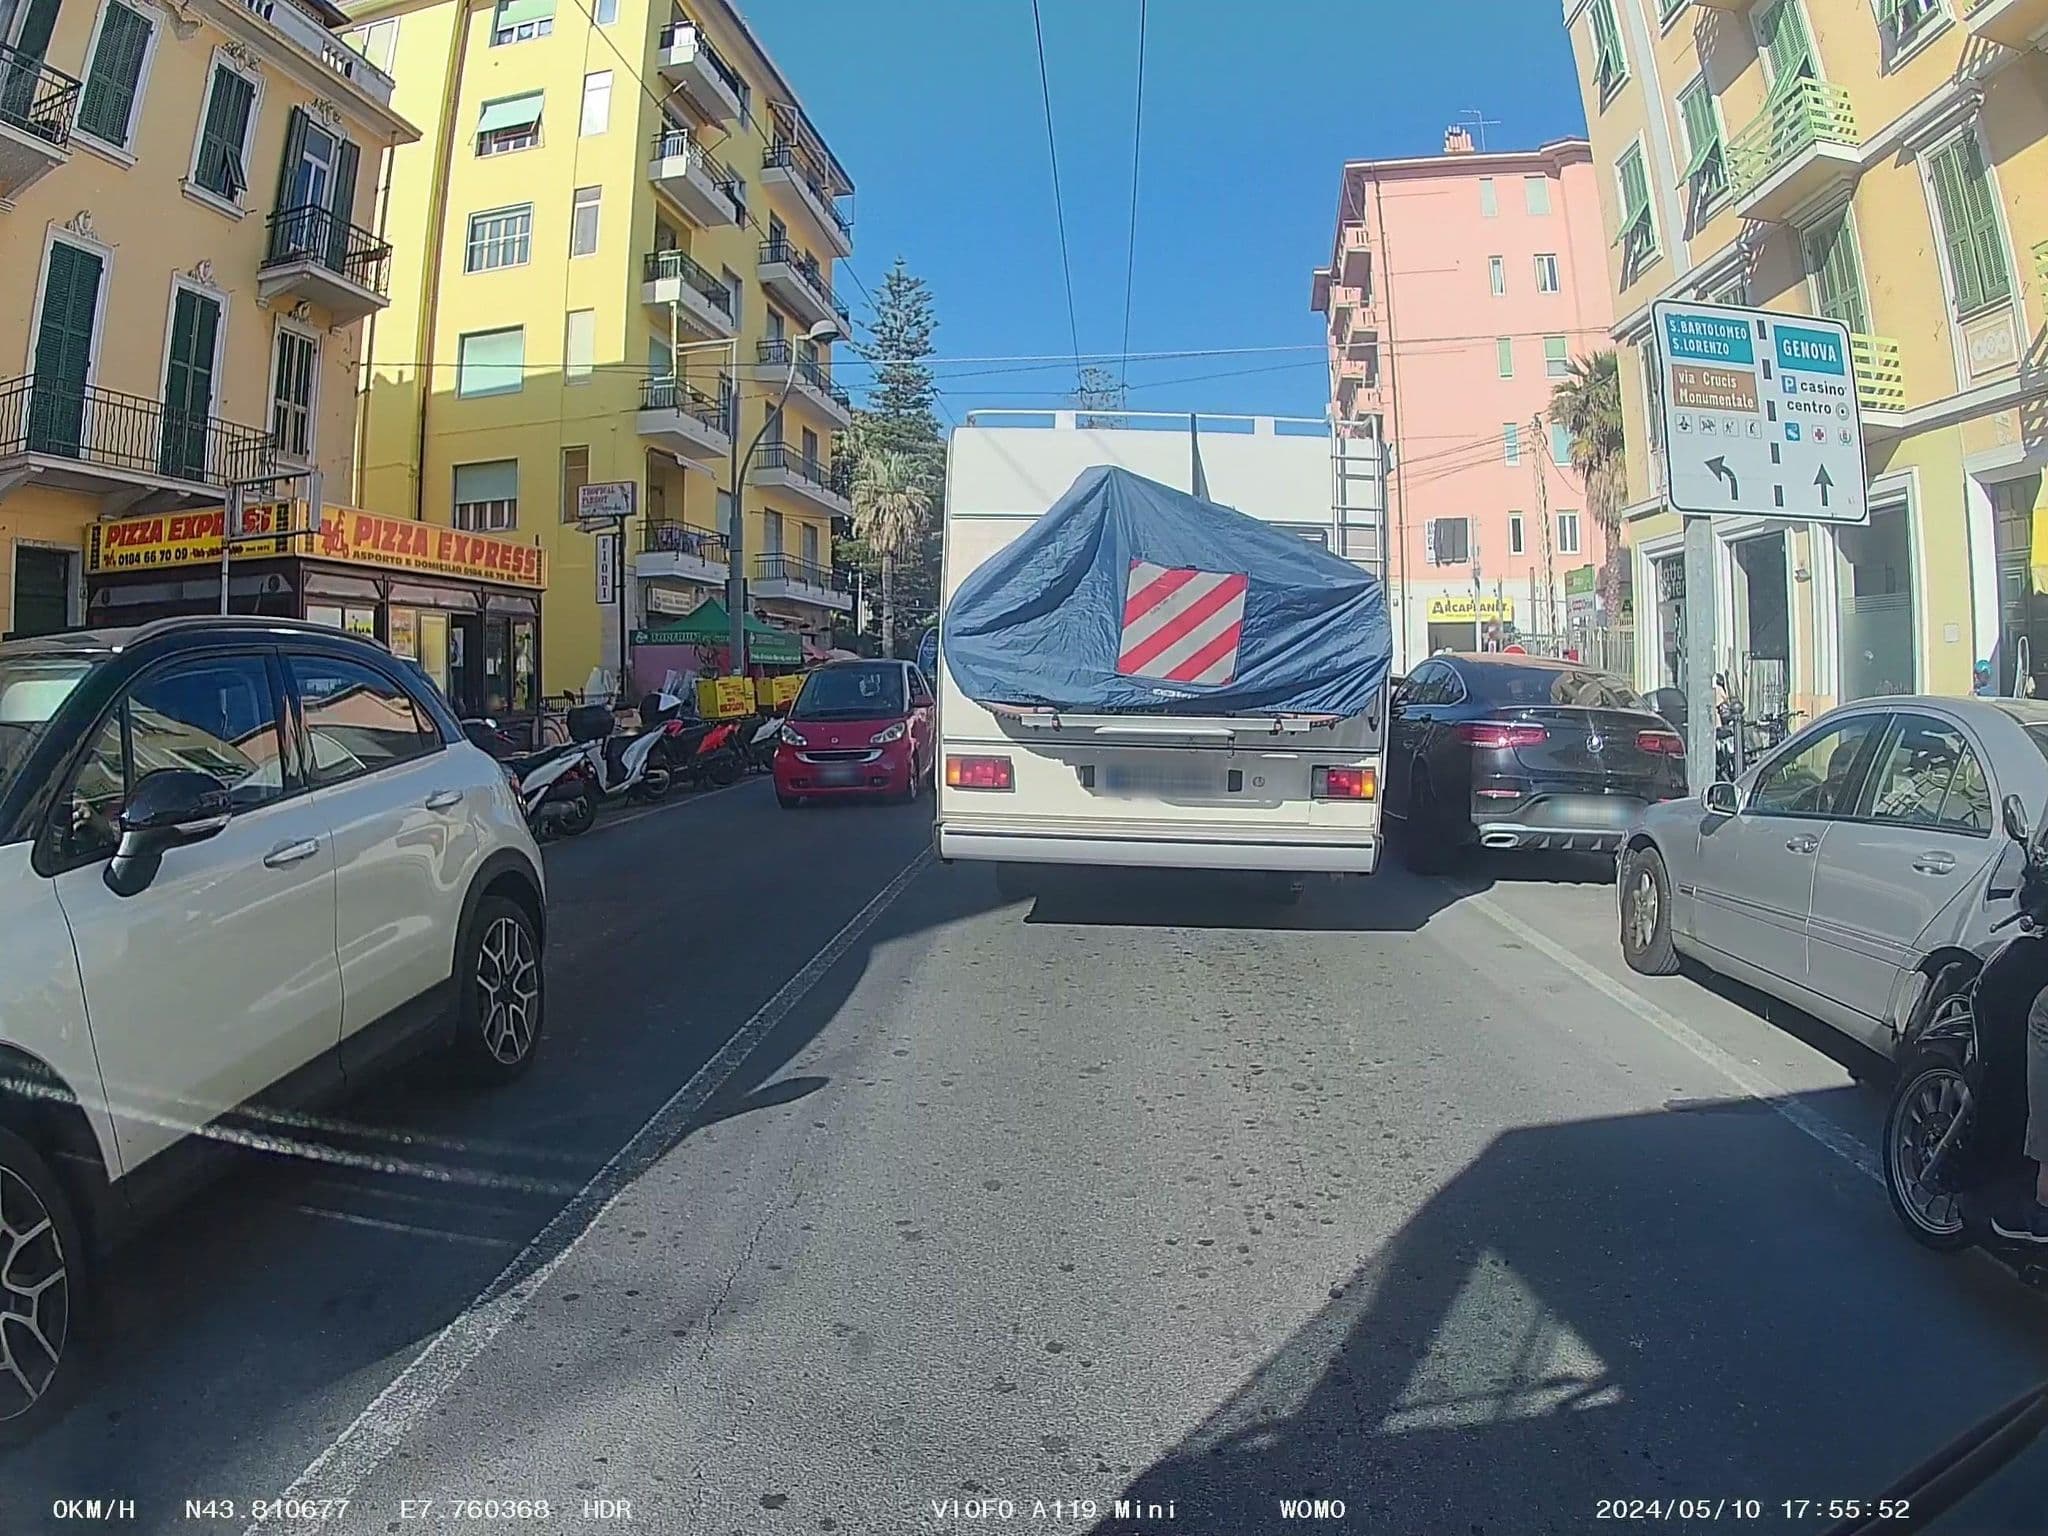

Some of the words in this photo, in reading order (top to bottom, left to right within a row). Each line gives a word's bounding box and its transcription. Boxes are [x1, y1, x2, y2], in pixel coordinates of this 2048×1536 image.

[1669, 319, 1747, 341] S.BARTOLOMEO
[1672, 337, 1730, 356] S.LORENZO
[1782, 339, 1838, 362] GENOVA
[1678, 371, 1696, 385] via
[1702, 373, 1738, 389] Crucis
[1800, 380, 1846, 397] casino
[1679, 388, 1755, 409] Monumentale
[1786, 399, 1832, 415] centro
[104, 518, 163, 548] PIZZA
[167, 505, 273, 542] EXPRSS
[354, 514, 429, 557] PIZZA
[437, 531, 537, 574] EXPRESS
[160, 549, 172, 562] 70
[352, 551, 403, 566] ASPORTO
[601, 538, 609, 599] FIORI
